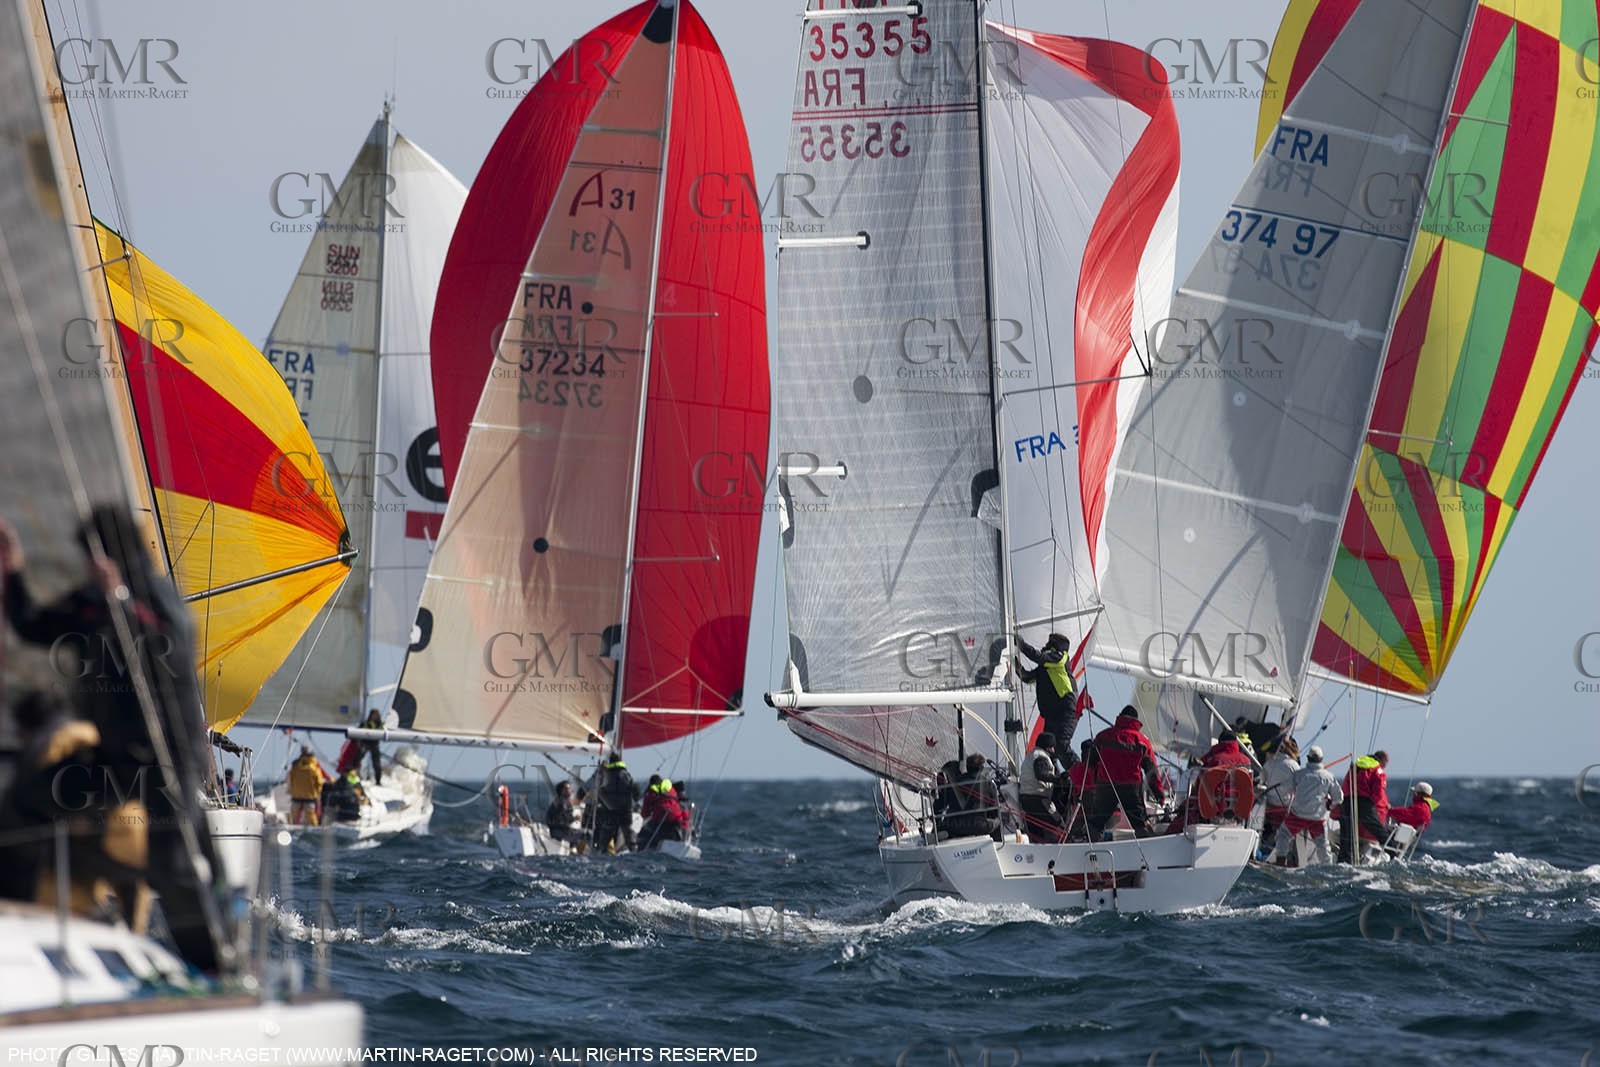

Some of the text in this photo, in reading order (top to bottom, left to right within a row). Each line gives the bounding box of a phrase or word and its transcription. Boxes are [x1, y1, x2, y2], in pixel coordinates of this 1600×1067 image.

[810, 17, 932, 62] 35355
[1271, 125, 1329, 167] FRA
[610, 188, 635, 211] 31
[1222, 210, 1341, 259] 374 97
[524, 283, 573, 310] FRA
[268, 349, 315, 374] FRA
[520, 346, 605, 378] 37234
[1015, 432, 1067, 463] FRA
